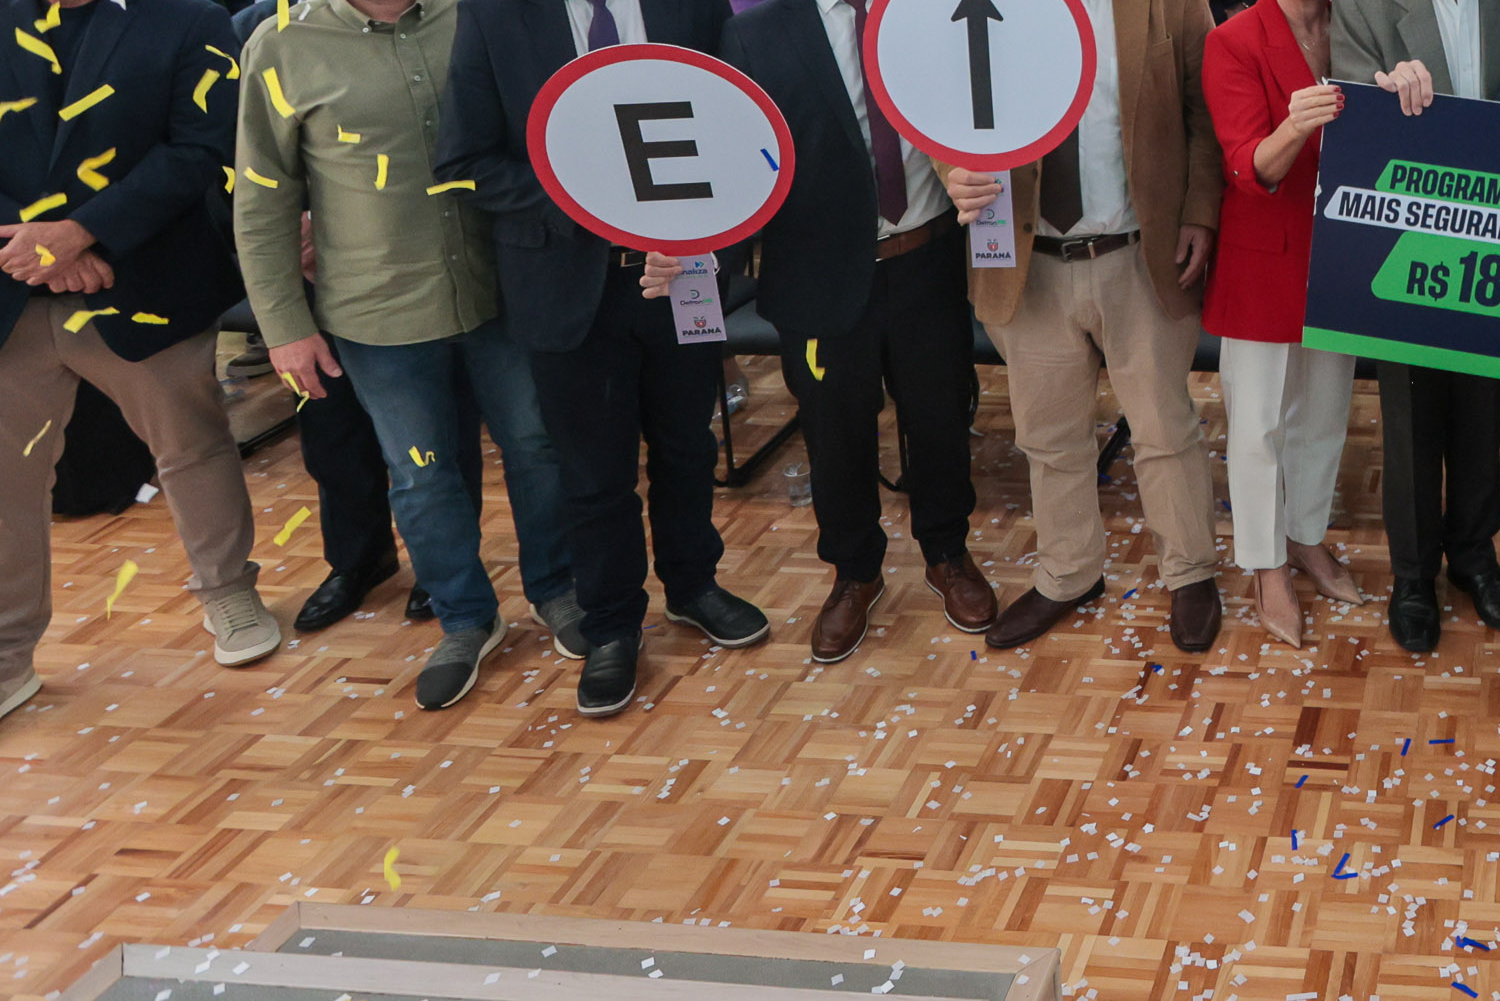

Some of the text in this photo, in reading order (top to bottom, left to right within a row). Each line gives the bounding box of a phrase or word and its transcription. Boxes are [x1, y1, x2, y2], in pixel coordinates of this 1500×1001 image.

[613, 101, 713, 202] E
[1338, 191, 1401, 224] MAIS
[975, 251, 1011, 259] PARANÁ
[1406, 261, 1451, 301] R$
[682, 327, 722, 336] PARANÁ
